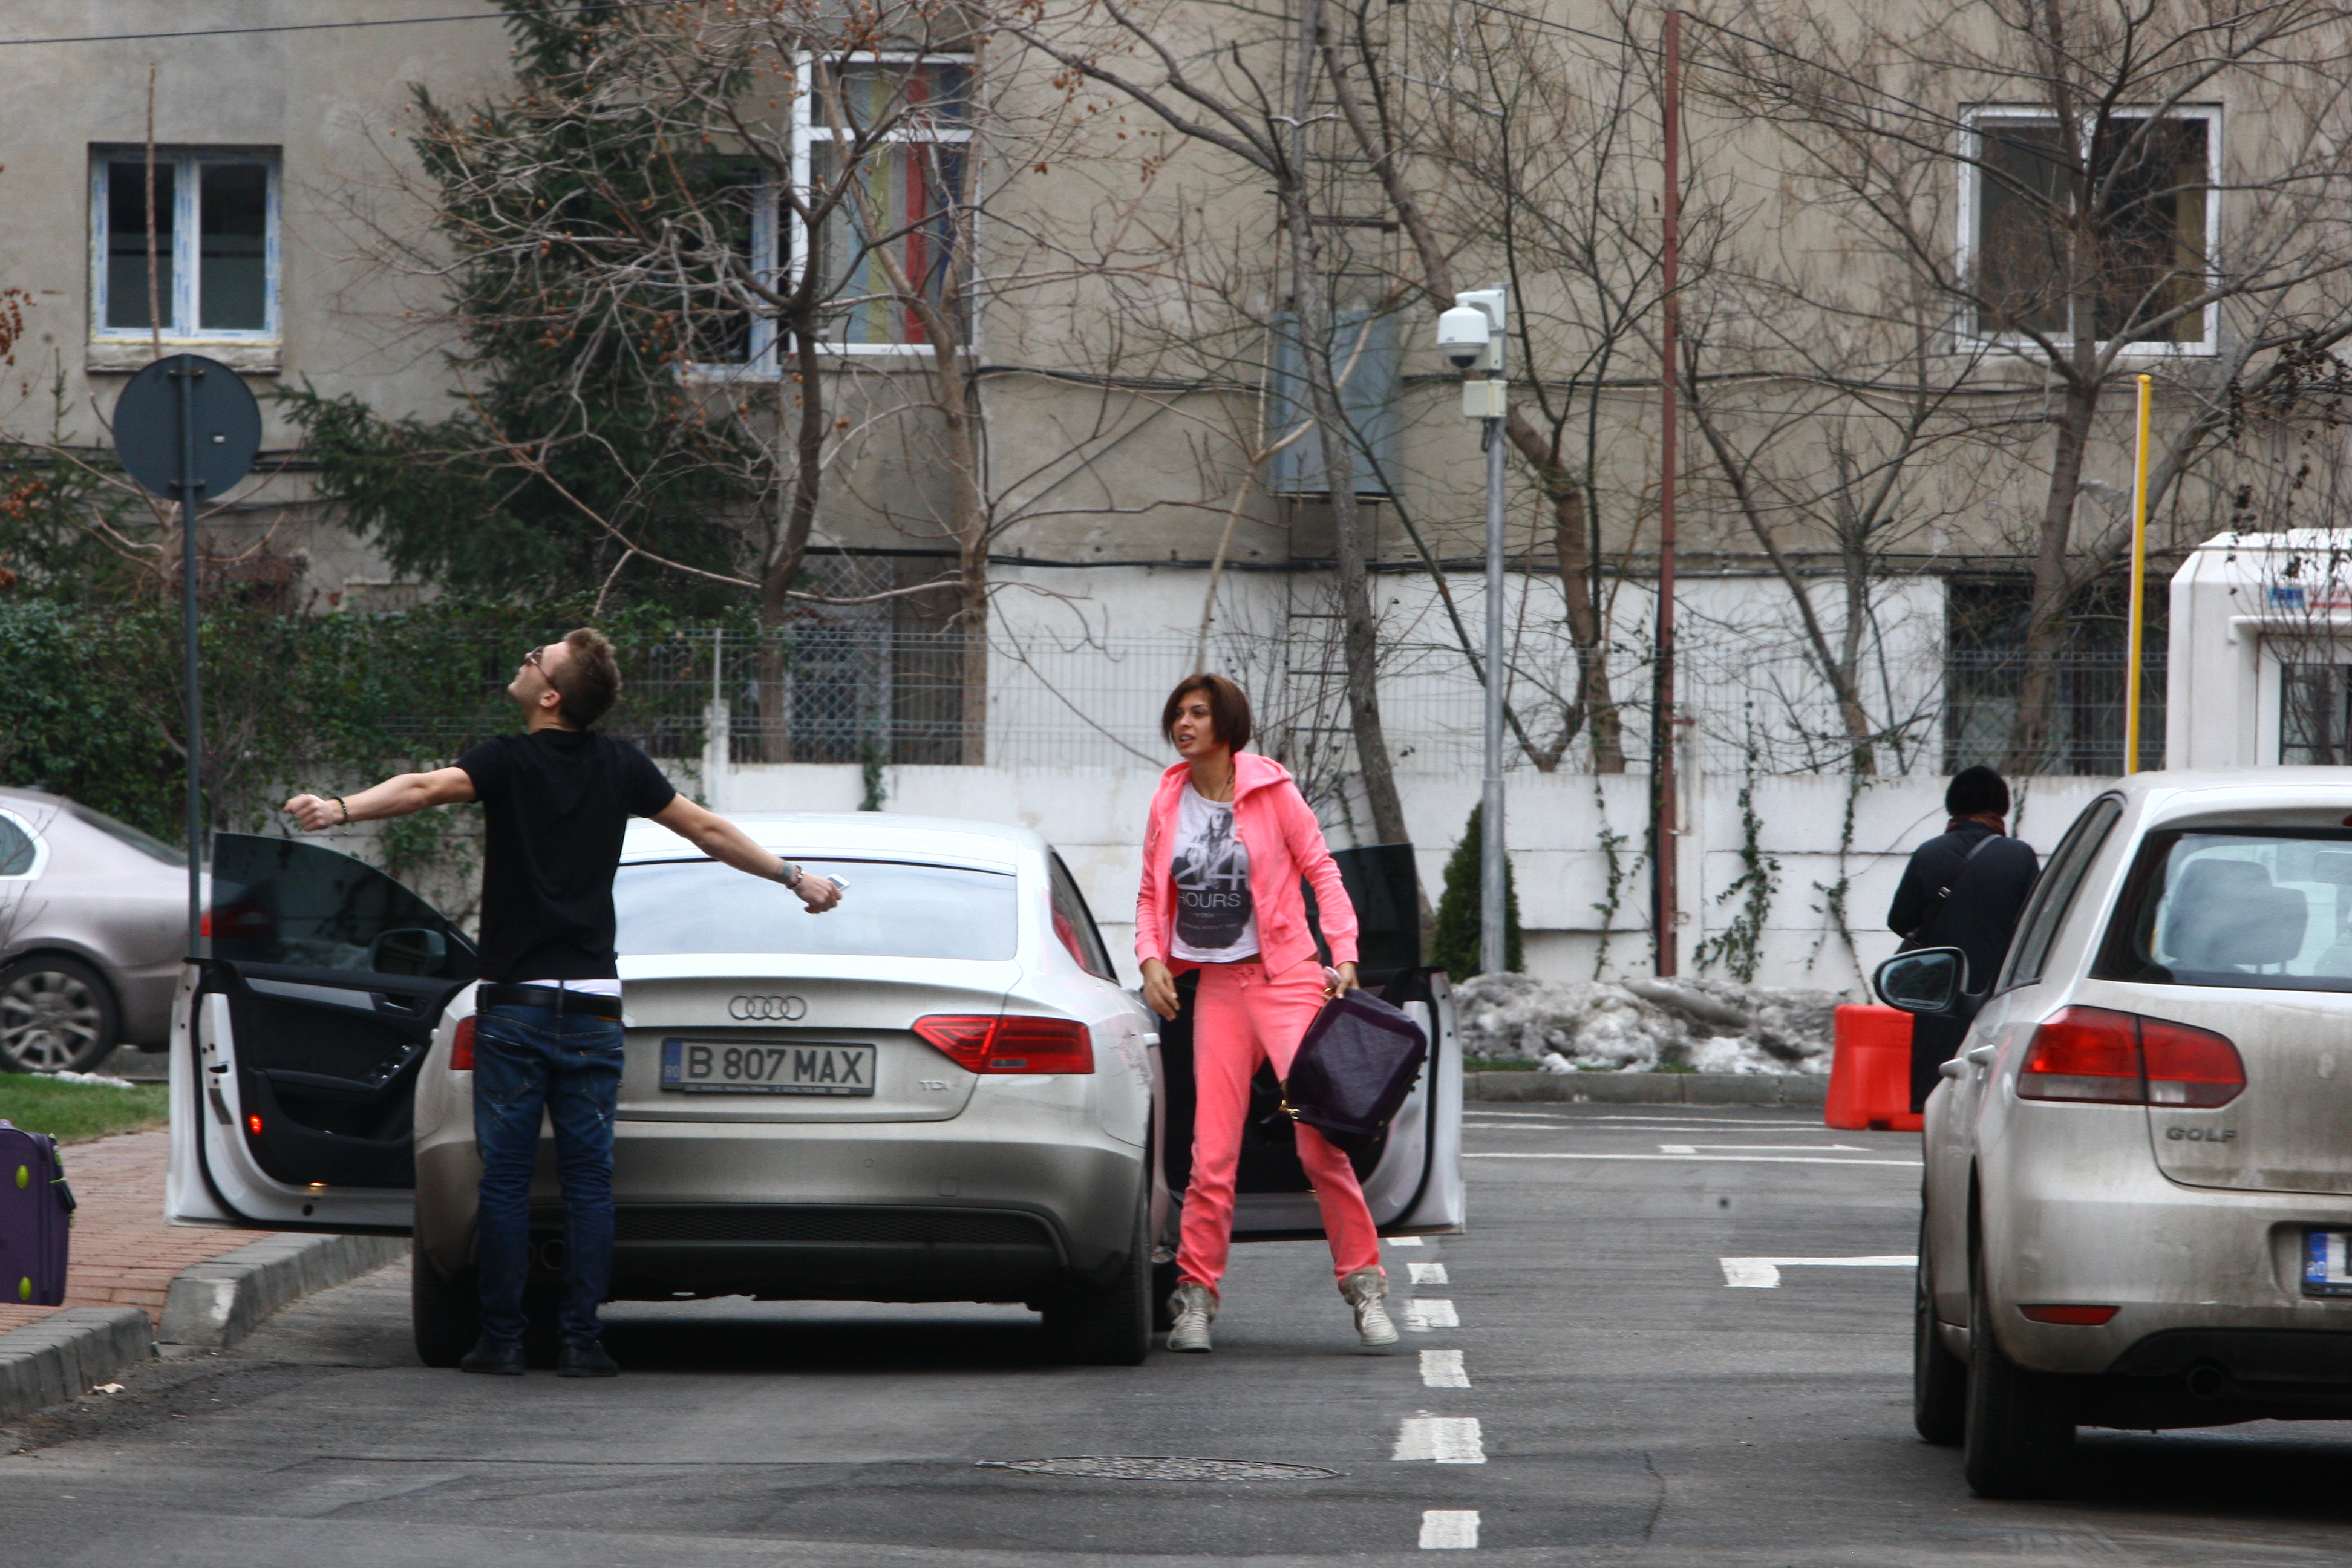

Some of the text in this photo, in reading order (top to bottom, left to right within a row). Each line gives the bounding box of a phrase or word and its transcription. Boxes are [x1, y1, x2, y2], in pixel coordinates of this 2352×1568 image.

[1174, 843, 1249, 891] 24
[1178, 892, 1241, 907] HOURS
[688, 1046, 863, 1083] B 807 MAX
[2166, 1125, 2237, 1143] GOLF
